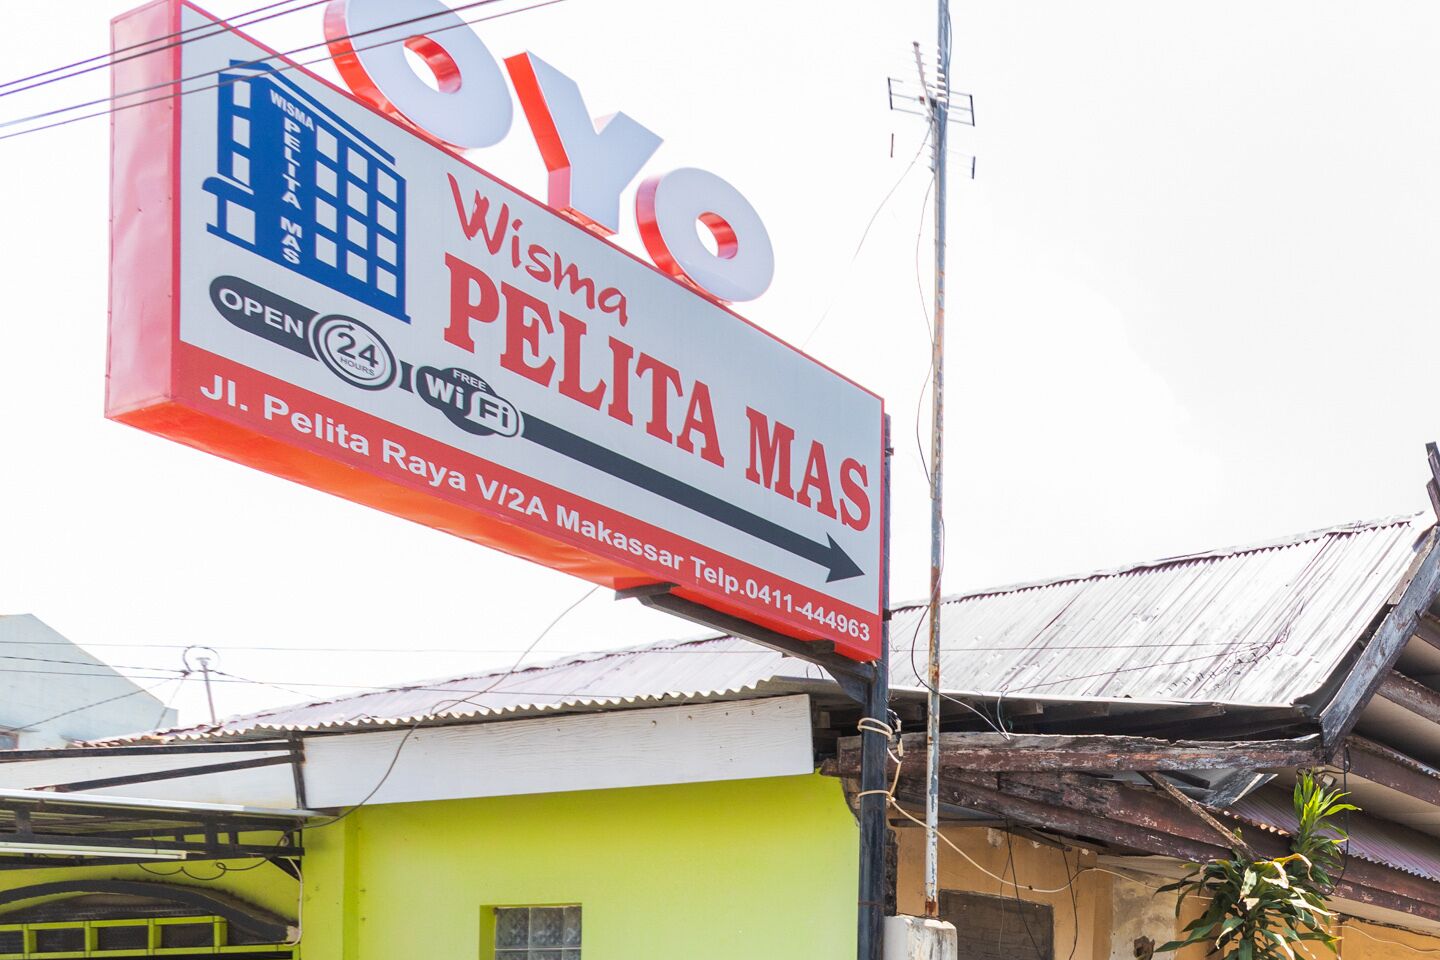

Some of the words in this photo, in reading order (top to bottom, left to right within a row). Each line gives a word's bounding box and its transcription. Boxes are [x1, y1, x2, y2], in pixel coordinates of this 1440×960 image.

[269, 88, 315, 132] WISMA
[283, 117, 302, 210] PELITA
[323, 0, 775, 302] OYO
[280, 217, 303, 265] MAS
[447, 172, 628, 327] Wisma
[219, 287, 304, 339] OPEN
[336, 323, 379, 368] 24
[339, 356, 376, 377] HOURS
[444, 252, 725, 468] PELITA
[745, 406, 871, 532] MAS
[453, 369, 487, 391] FREE
[264, 394, 370, 456] Pelita
[382, 440, 467, 491] Raya
[556, 504, 684, 571] Makassar
